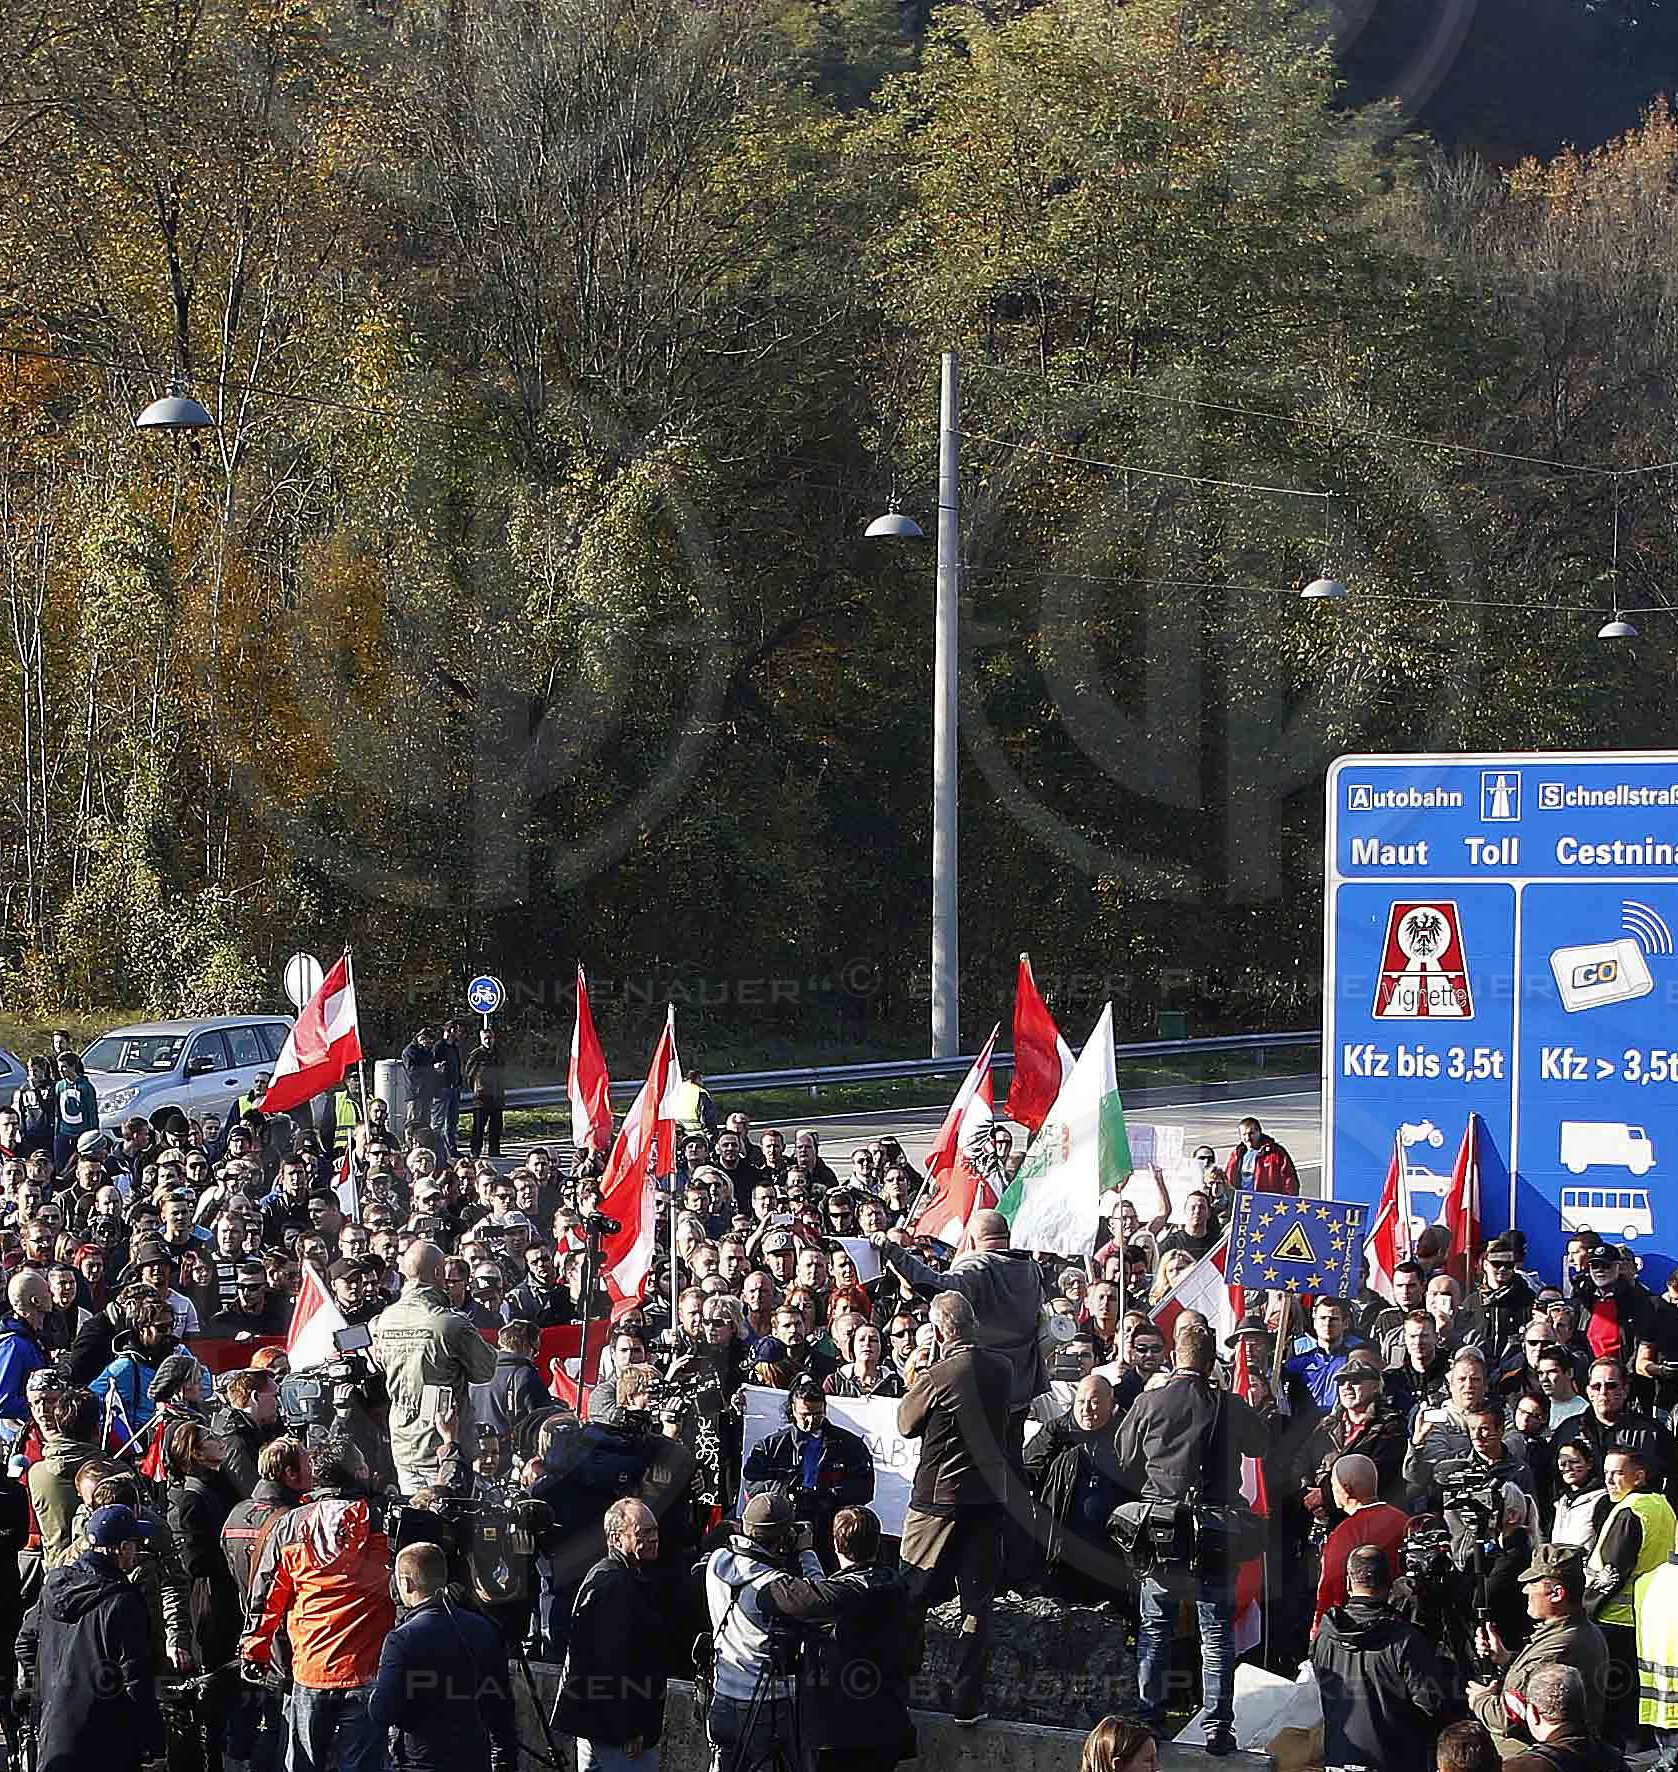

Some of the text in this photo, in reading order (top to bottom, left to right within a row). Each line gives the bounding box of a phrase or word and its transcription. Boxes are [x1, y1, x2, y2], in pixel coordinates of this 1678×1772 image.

[1349, 785, 1463, 810] Autobahn
[1351, 838, 1428, 865] Maut
[1465, 837, 1518, 865] Toll
[1582, 961, 1617, 983] GO
[1381, 982, 1467, 1010] Vignette
[1343, 1044, 1504, 1082] Kfz bis 3,5t
[1541, 1047, 1588, 1080] Kfz
